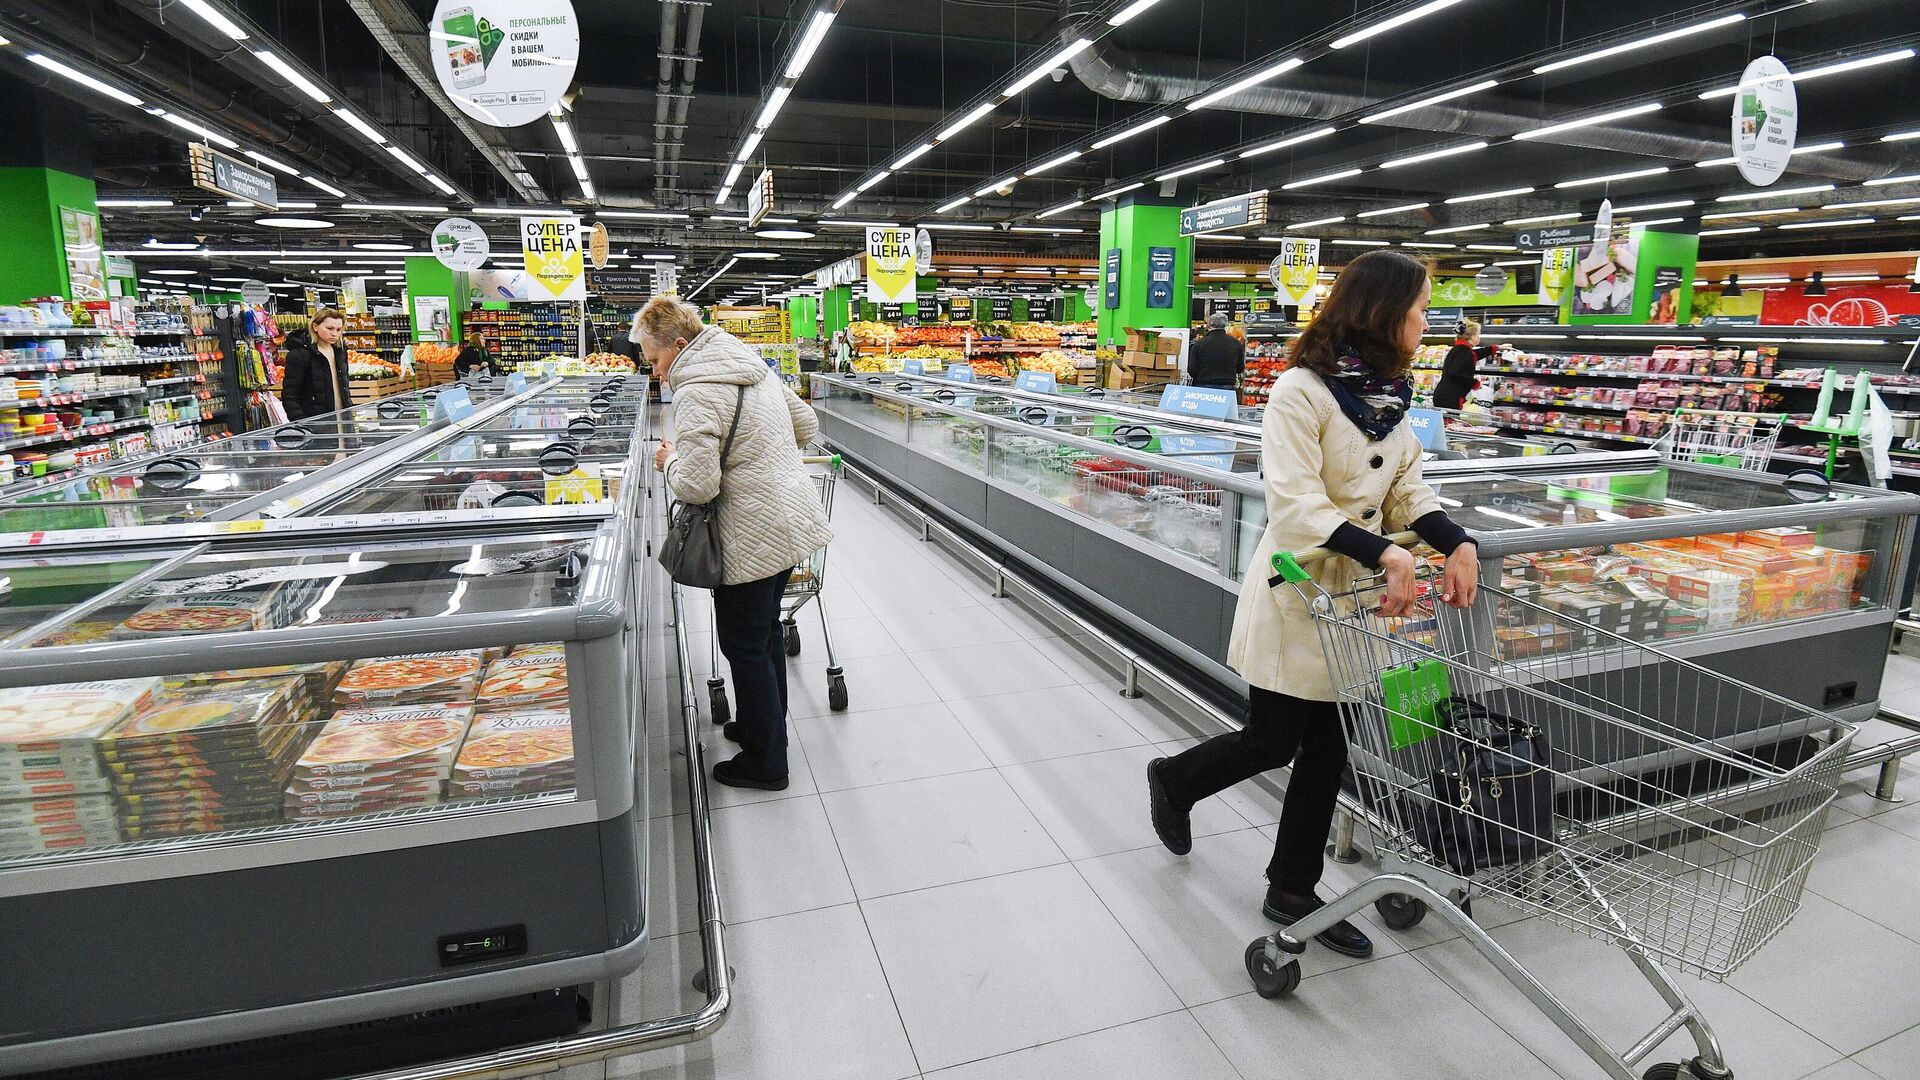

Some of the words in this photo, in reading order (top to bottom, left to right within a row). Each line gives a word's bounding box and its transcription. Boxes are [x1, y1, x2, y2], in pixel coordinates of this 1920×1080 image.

[509, 15, 567, 28] ПЕРСОНАЛЬНЫЕ
[510, 31, 539, 42] СКИДКИ
[511, 45, 517, 55] В
[517, 44, 544, 54] ВАШЕМ
[1196, 204, 1243, 220] Замороженные
[526, 223, 576, 236] СУПЕР
[1196, 216, 1225, 230] продукты
[871, 231, 911, 243] СУПЕР
[1539, 235, 1591, 245] гастрономия
[1540, 229, 1571, 238] Рыбная
[527, 237, 578, 254] ЦЕНА
[871, 244, 912, 259] ЦЕНА
[1285, 242, 1316, 254] СУПЕР
[1284, 254, 1315, 268] ЦЕНА
[1545, 259, 1569, 271] ЦЕНА
[350, 709, 451, 723] Ristorante
